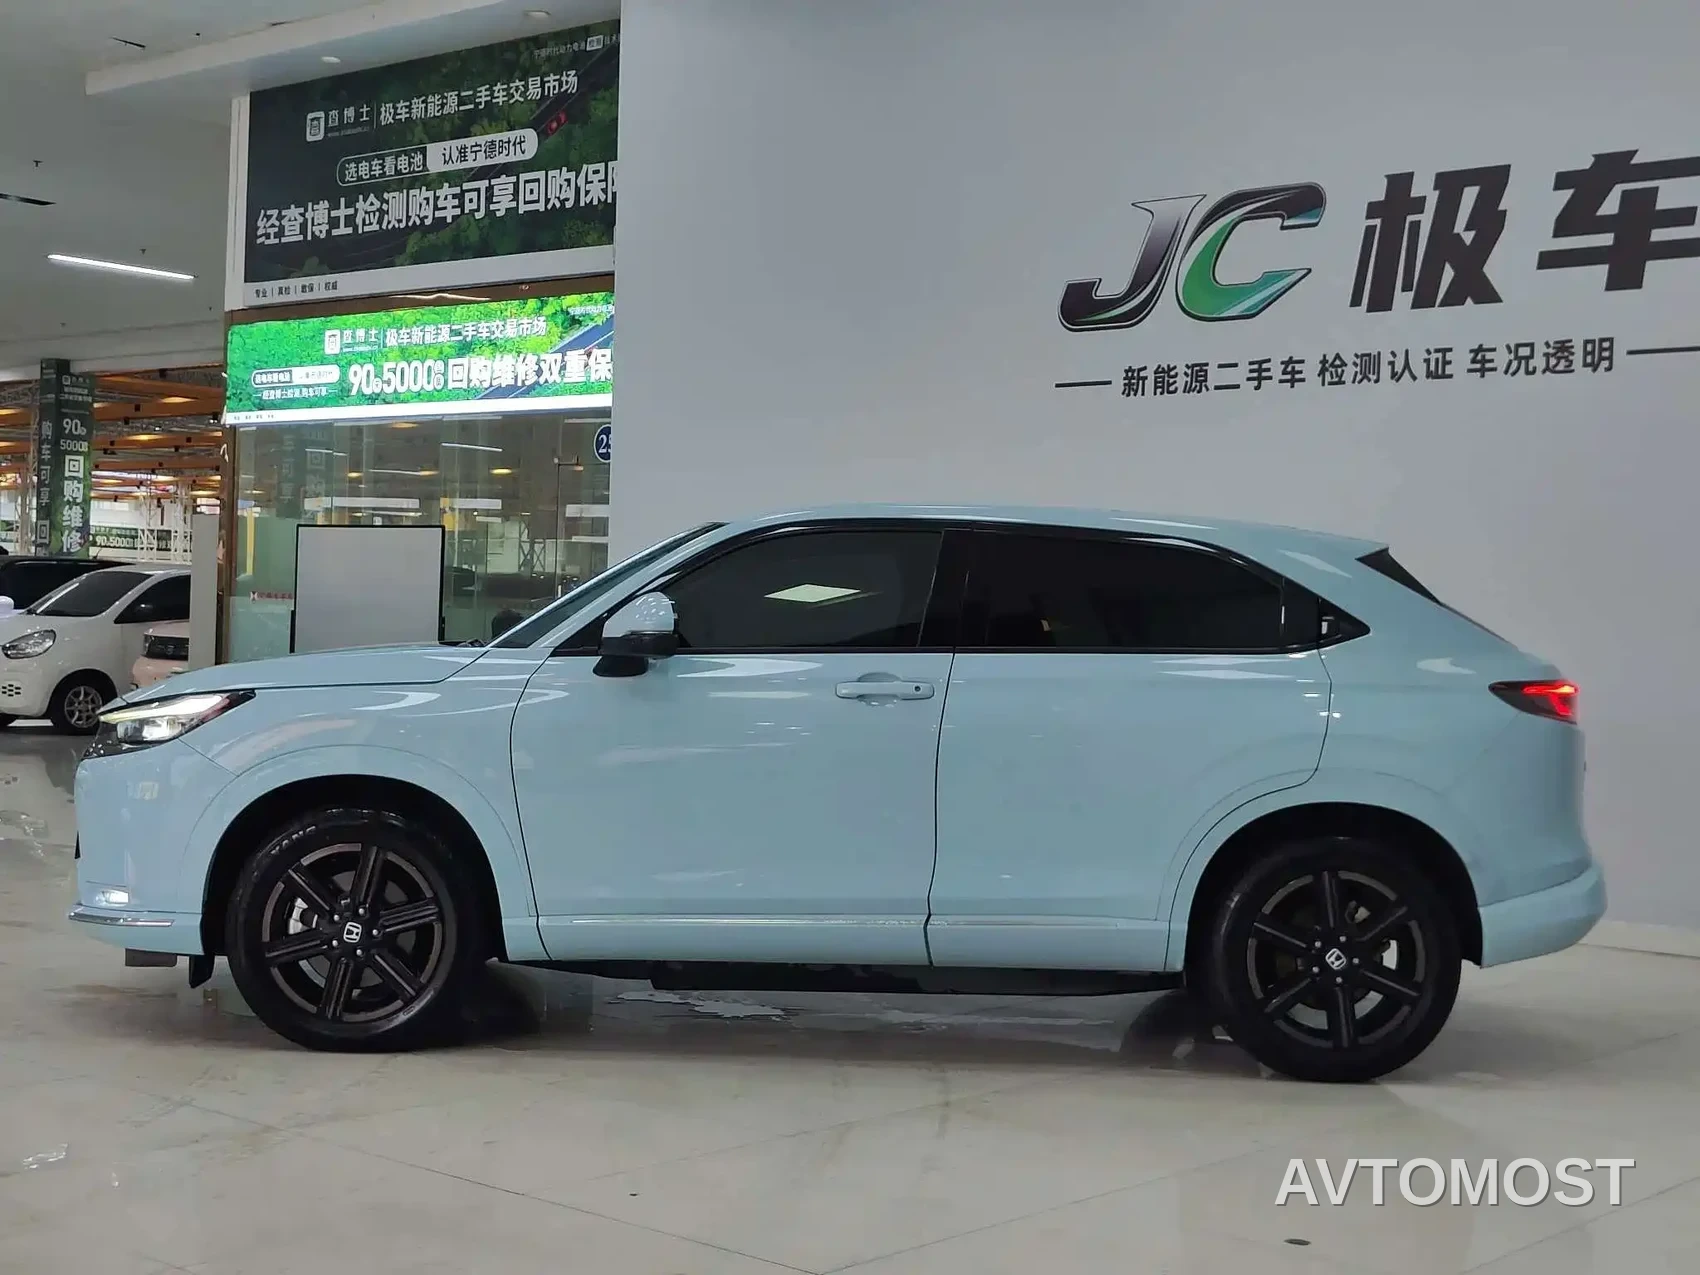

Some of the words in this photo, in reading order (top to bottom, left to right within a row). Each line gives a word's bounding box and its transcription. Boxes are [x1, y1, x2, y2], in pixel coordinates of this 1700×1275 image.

[380, 70, 578, 126] 极车新能源二手车交易市场
[345, 153, 424, 182] 选电车看电池
[442, 136, 527, 166] 认准宁德时代
[1058, 181, 1327, 332] JC
[386, 316, 546, 346] 极车新能源二手车交易市场
[1121, 357, 1307, 398] 新能源二手车
[1317, 347, 1454, 388] 检测认证
[1466, 337, 1615, 378] 车况透明
[61, 454, 84, 553] 回购维修
